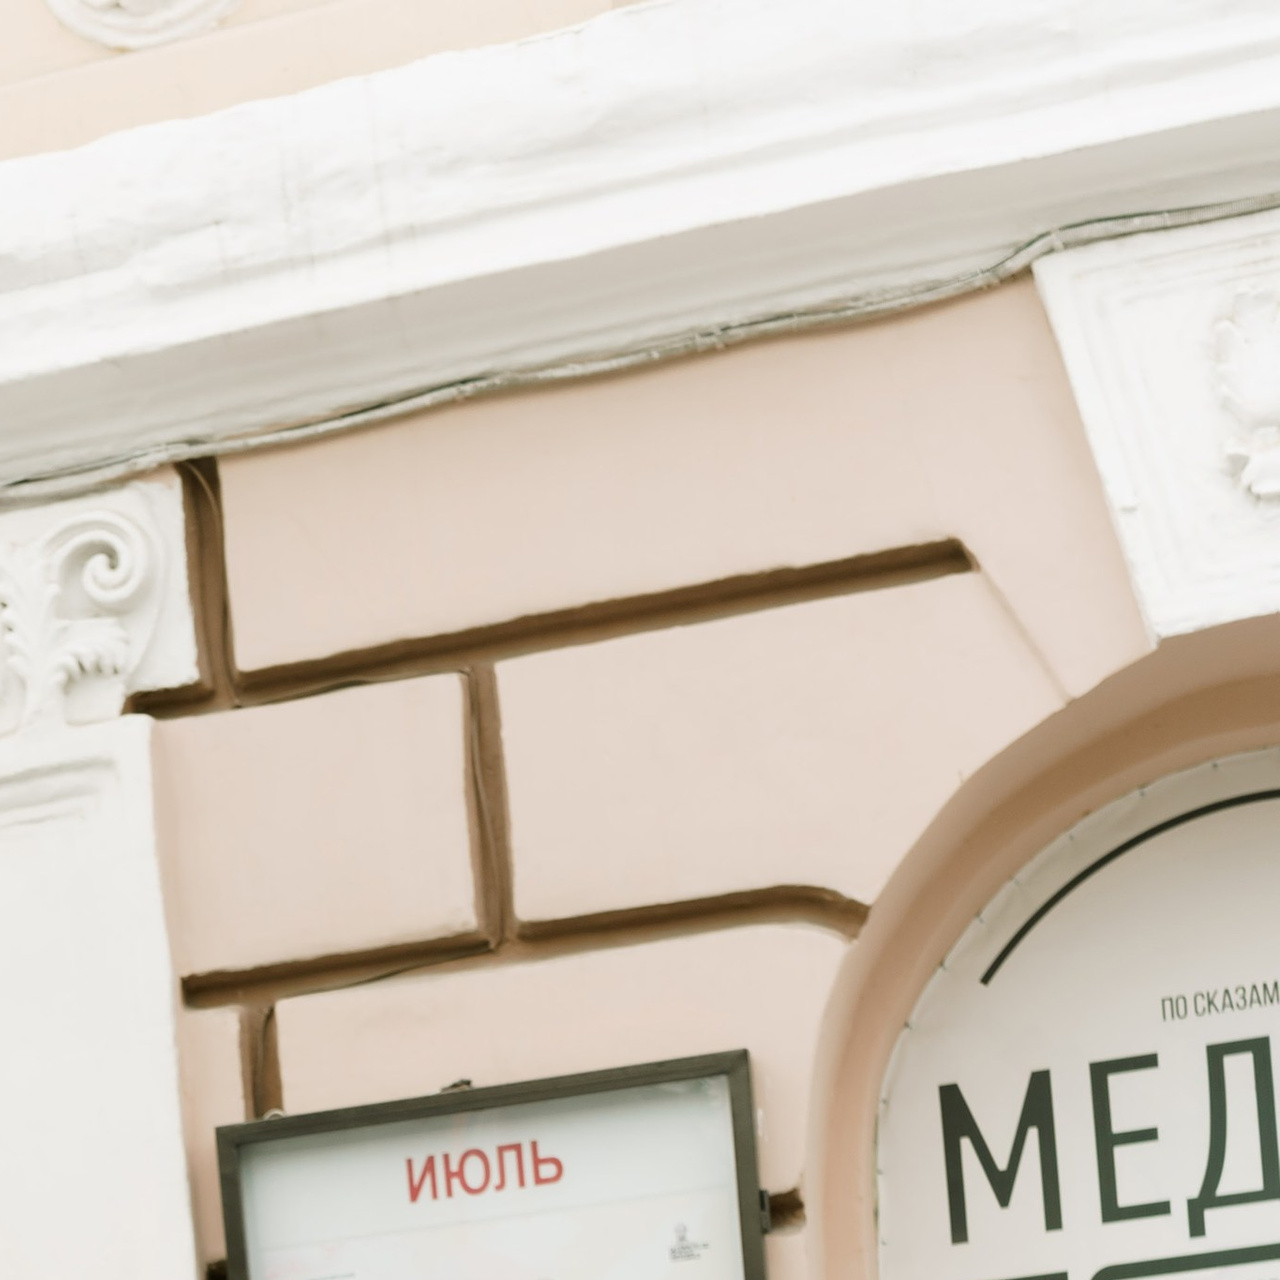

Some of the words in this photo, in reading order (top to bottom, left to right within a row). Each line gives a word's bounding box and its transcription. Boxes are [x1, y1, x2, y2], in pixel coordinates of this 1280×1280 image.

[1161, 994, 1188, 1021] ПО
[405, 1139, 564, 1203] ИЮЛЬ
[938, 1036, 1280, 1245] МЕД
